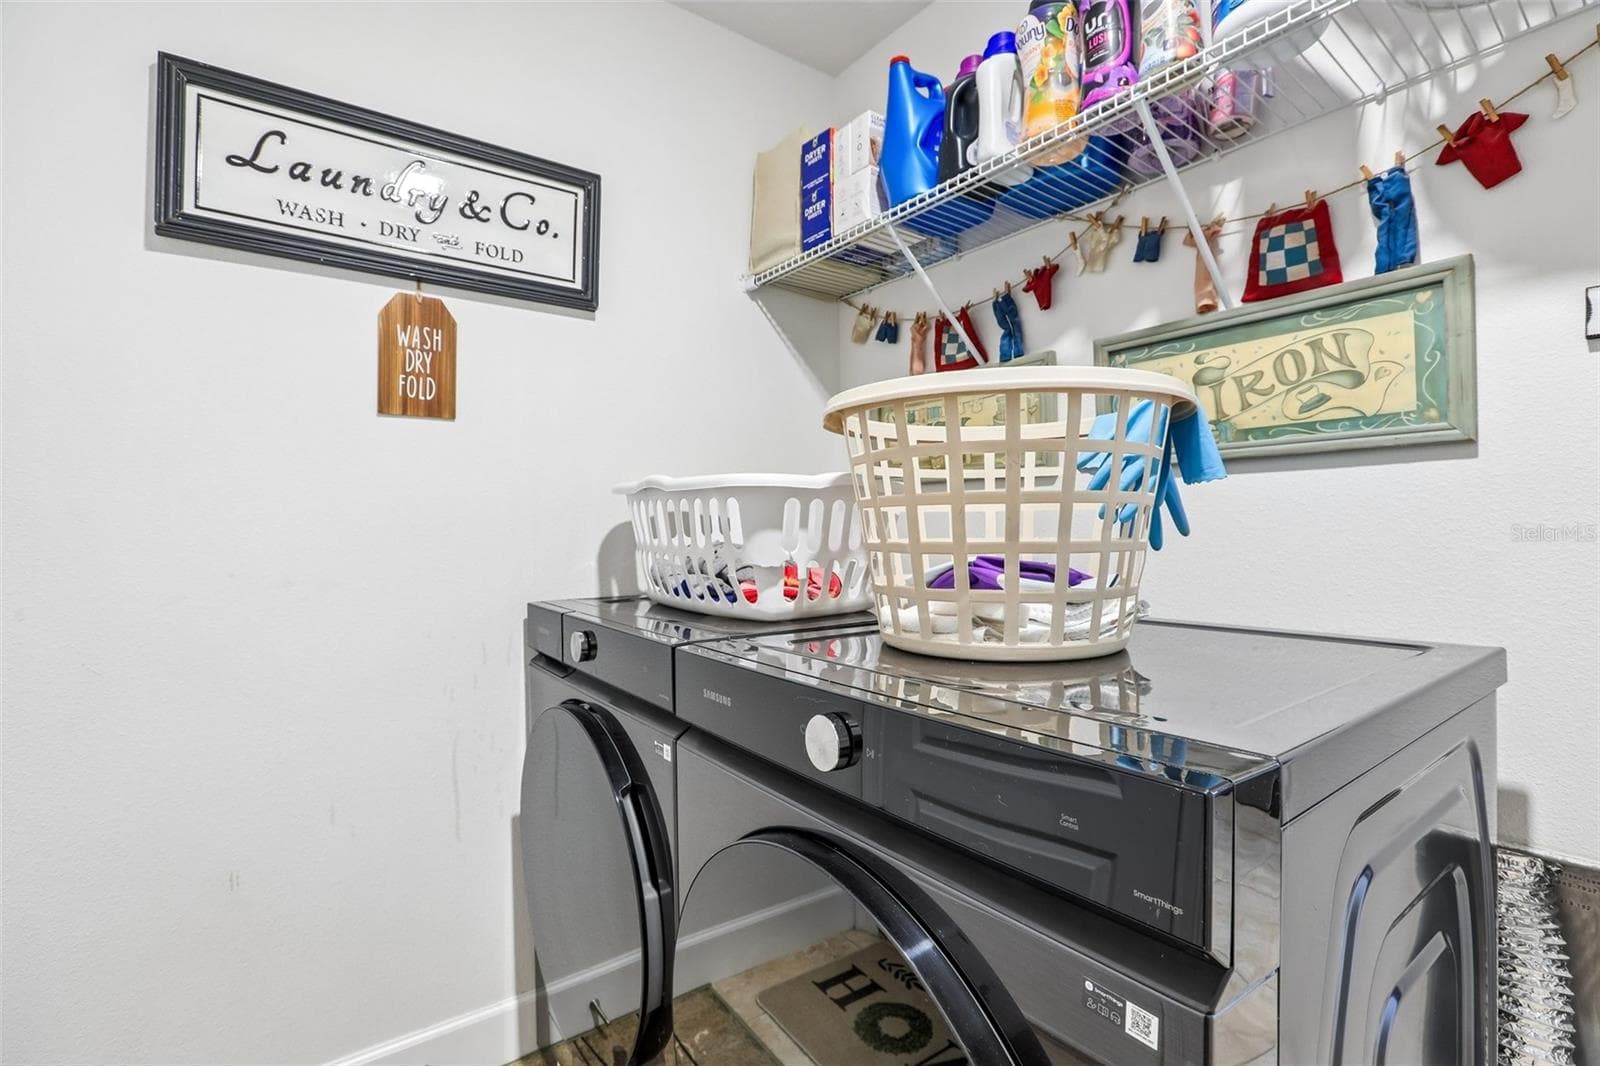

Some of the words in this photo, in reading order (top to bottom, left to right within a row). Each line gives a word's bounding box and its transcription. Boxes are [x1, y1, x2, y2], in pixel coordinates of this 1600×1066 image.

[804, 144, 827, 163] DRYER
[804, 199, 826, 217] DRYER
[275, 198, 345, 228] WASH
[378, 219, 421, 243] DRY
[474, 241, 524, 263] FOLD
[396, 323, 442, 352] WASH
[405, 349, 432, 374] DRY
[398, 374, 436, 401] FOLD
[1206, 331, 1357, 421] IRON
[703, 688, 732, 707] SAMSUNG
